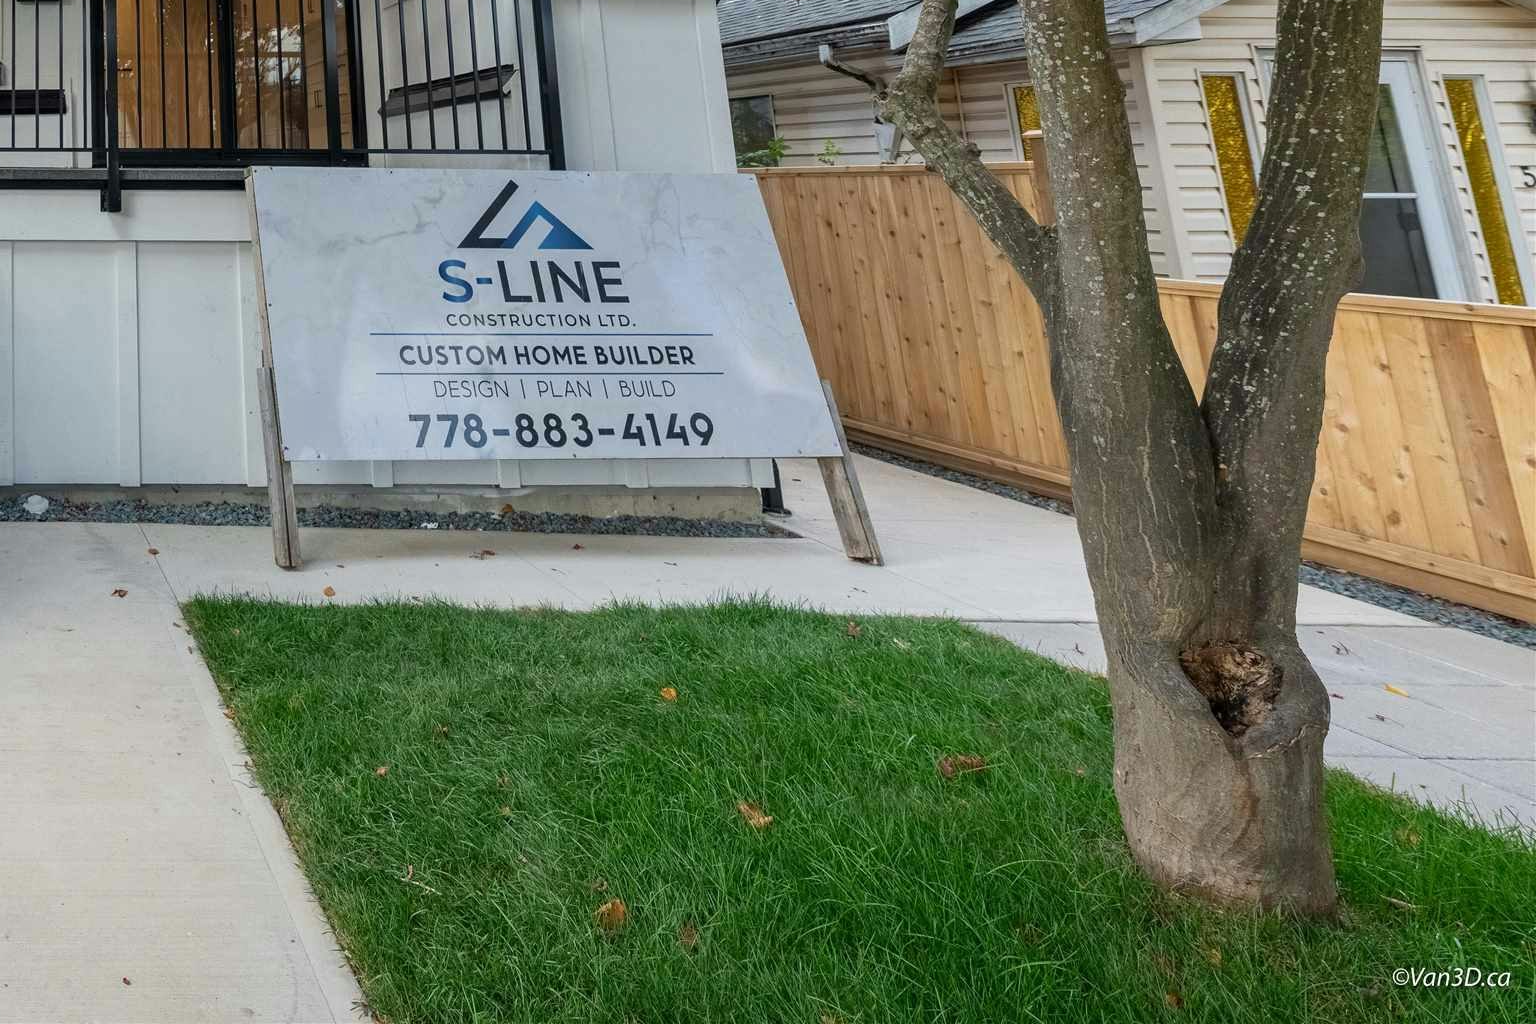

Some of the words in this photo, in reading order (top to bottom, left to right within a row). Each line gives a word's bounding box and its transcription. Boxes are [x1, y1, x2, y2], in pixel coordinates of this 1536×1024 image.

[438, 259, 630, 303] S-LINE
[446, 314, 591, 327] CONSTRUCTION
[598, 314, 636, 327] LTD.
[400, 345, 507, 365] CUSTOM
[514, 345, 587, 365] HOME
[595, 346, 696, 366] BUILDER
[434, 380, 509, 398] DESIGN
[537, 380, 592, 398] PLAN
[619, 380, 676, 398] BUILD
[408, 412, 715, 448] 778-883-4149
